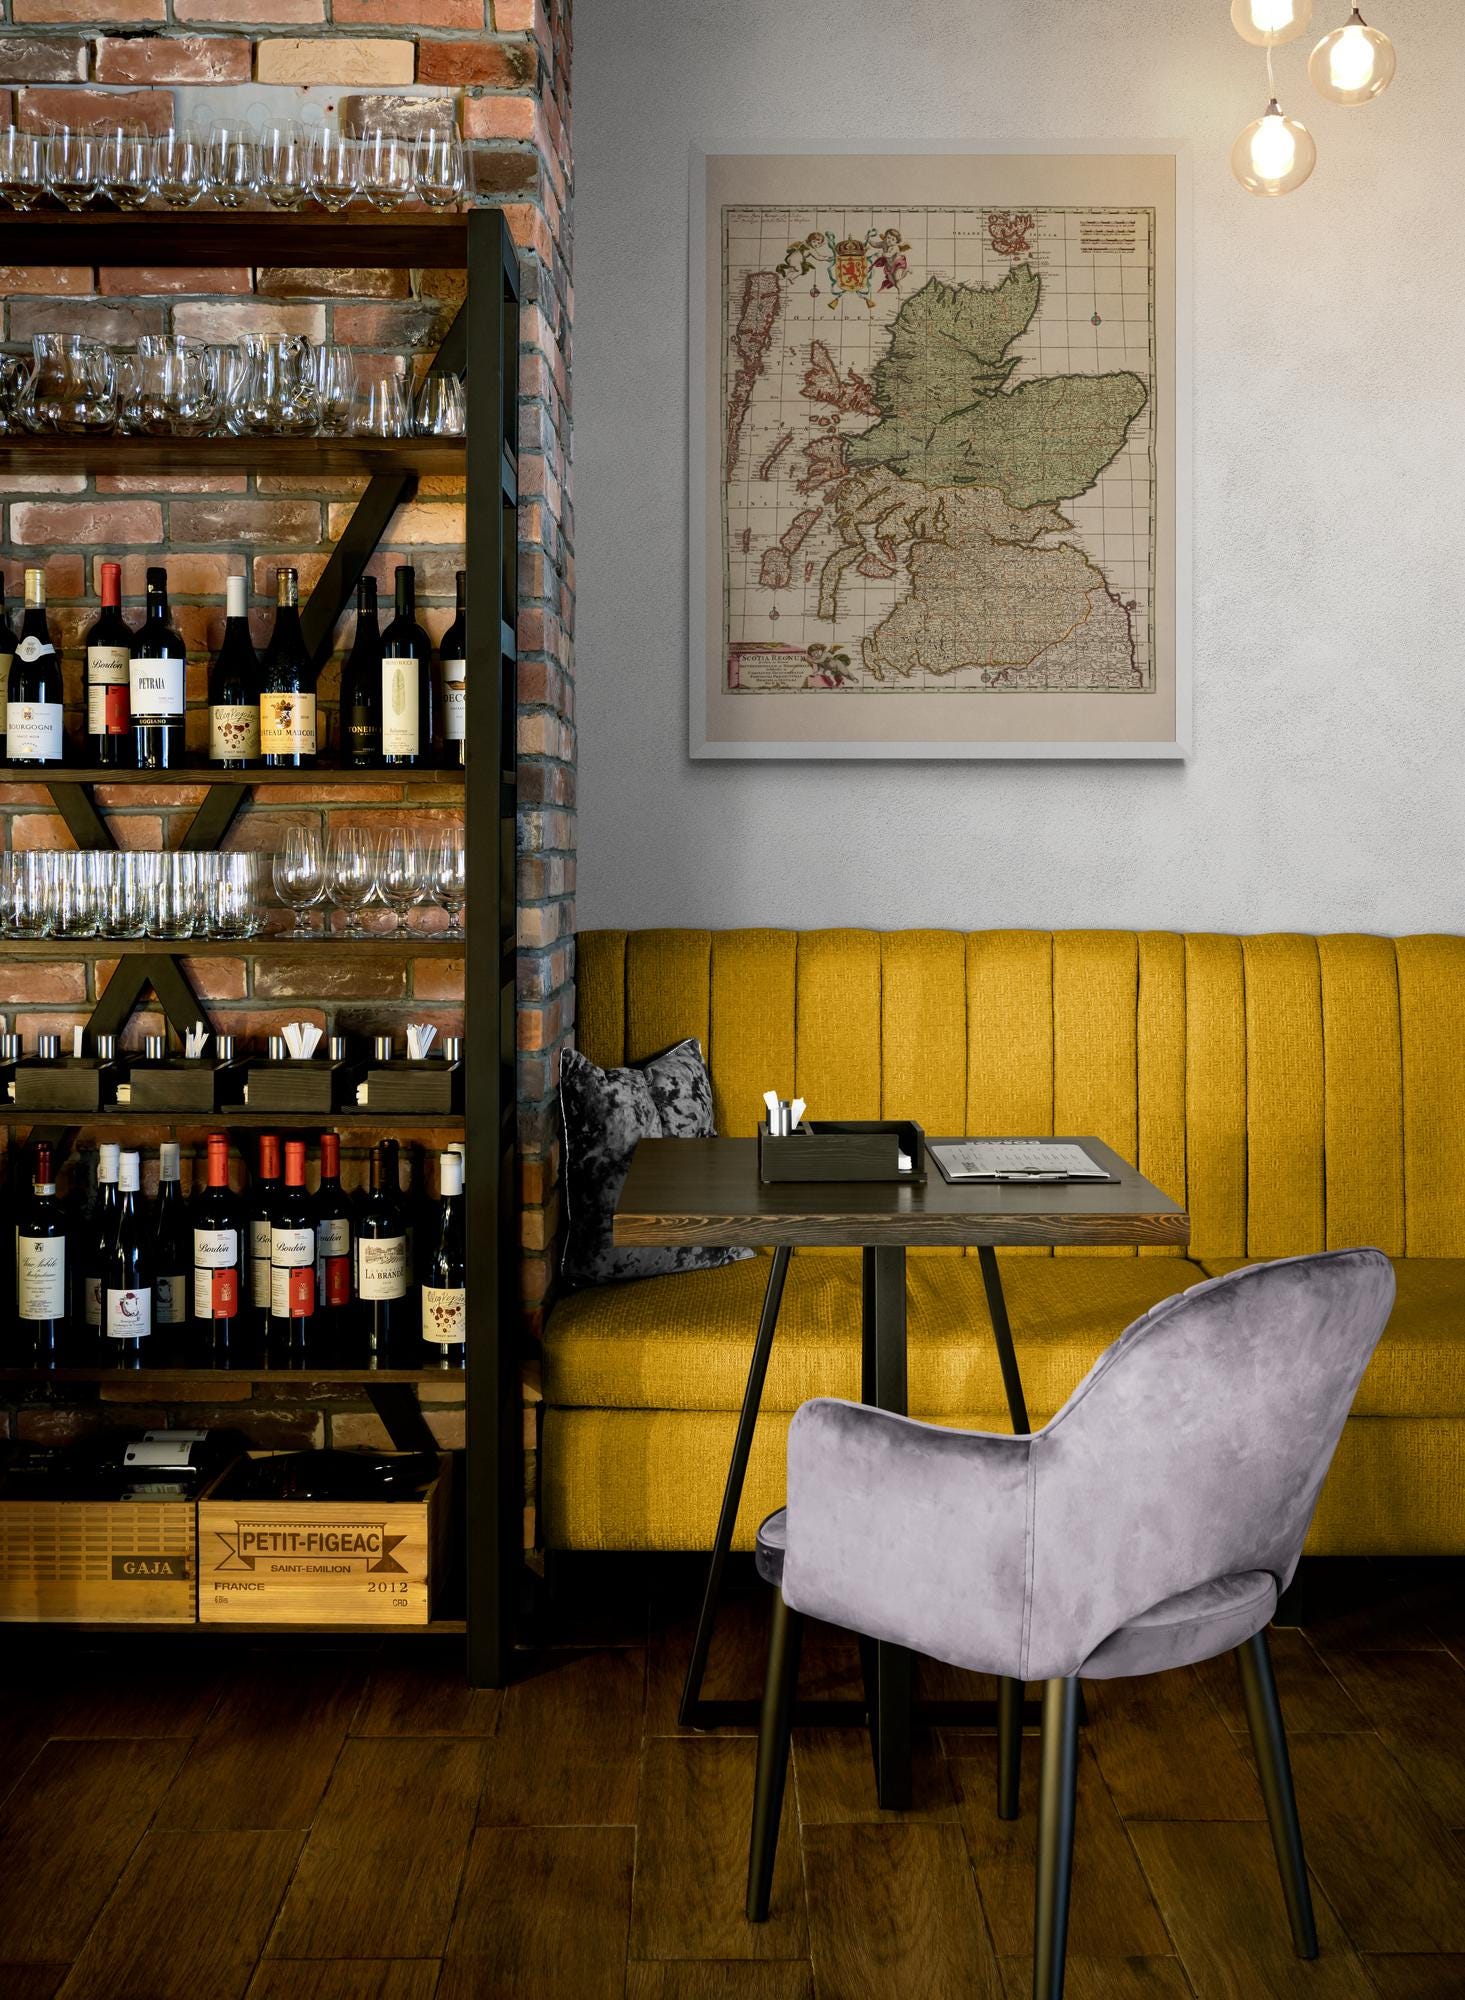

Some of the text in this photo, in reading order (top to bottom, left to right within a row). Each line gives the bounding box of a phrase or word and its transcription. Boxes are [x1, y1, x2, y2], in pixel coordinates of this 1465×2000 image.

[138, 677, 165, 690] PETRAIA
[443, 693, 465, 703] DEC
[9, 723, 53, 731] BOURGOGNE
[243, 1532, 380, 1553] PETIT-FIGEAC
[123, 1561, 174, 1575] GAJA
[270, 1564, 351, 1574] SAINT-EMILION
[214, 1581, 409, 1593] FRANCE 2012
[392, 1598, 408, 1607] CRD
